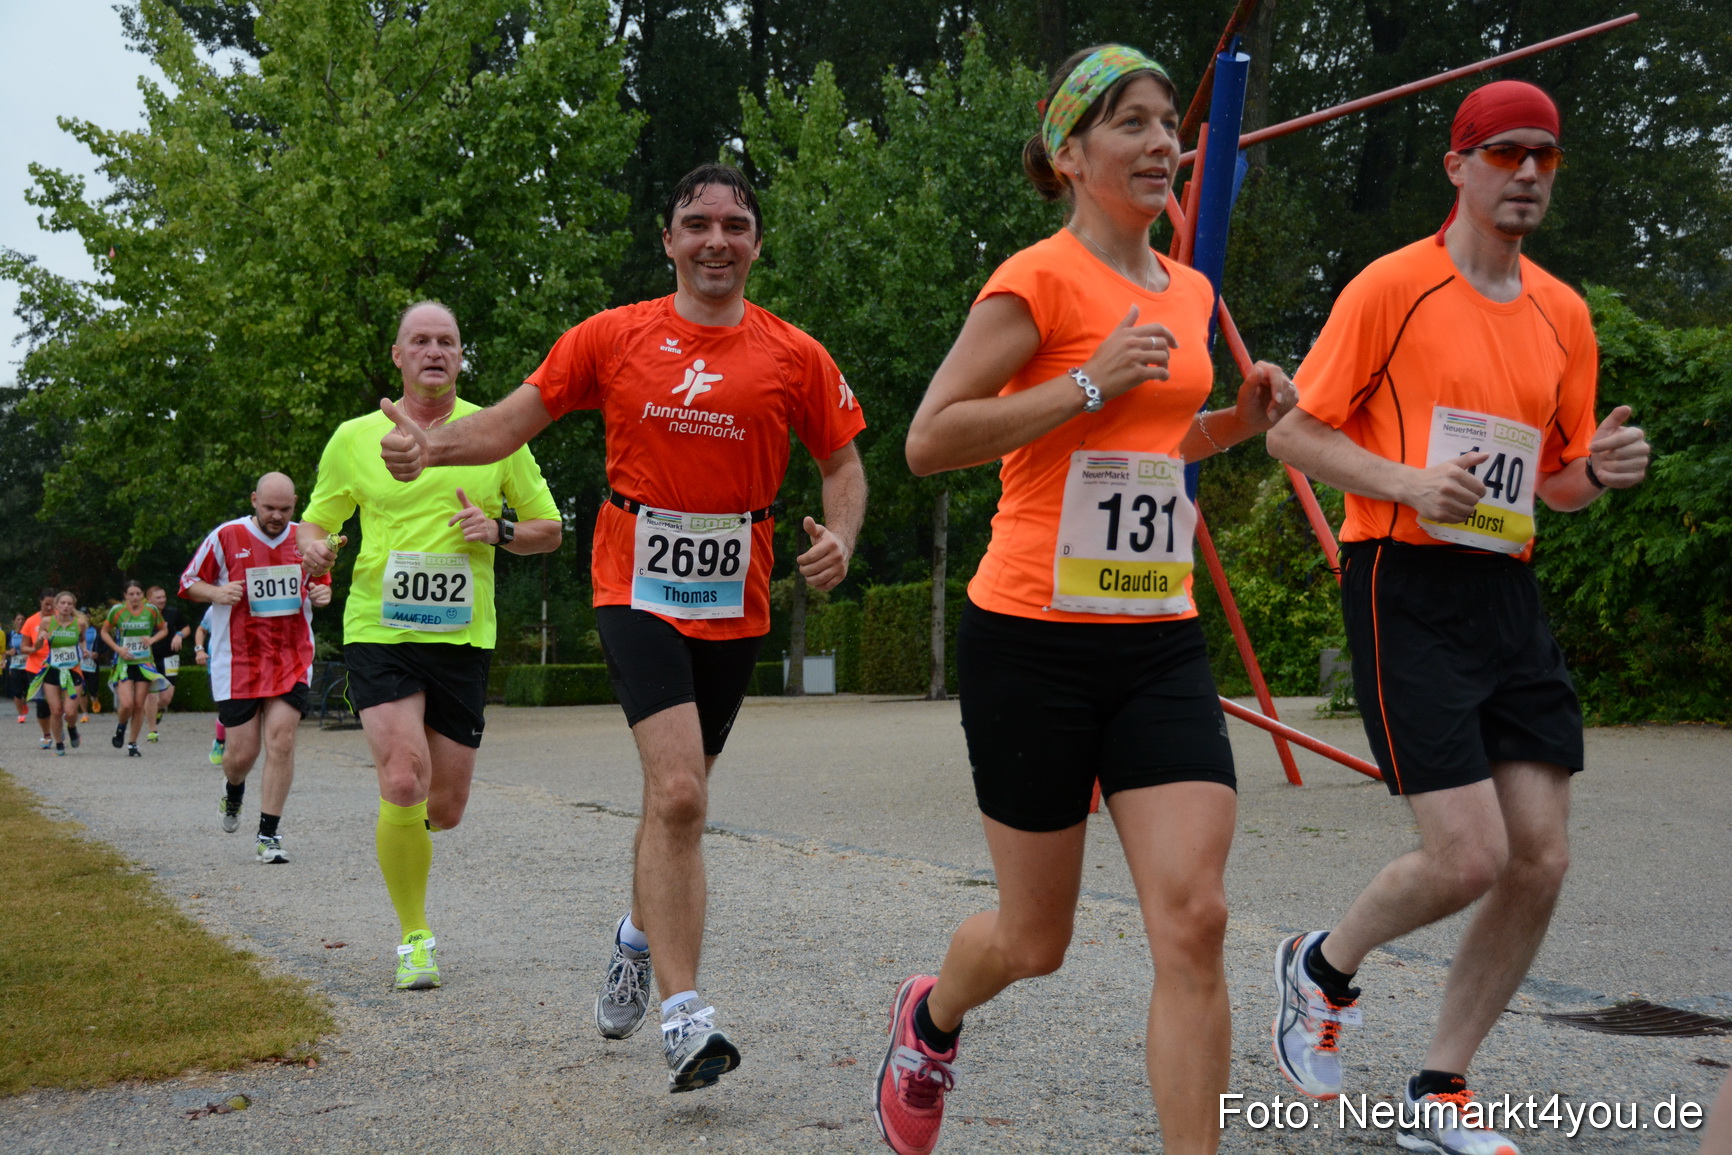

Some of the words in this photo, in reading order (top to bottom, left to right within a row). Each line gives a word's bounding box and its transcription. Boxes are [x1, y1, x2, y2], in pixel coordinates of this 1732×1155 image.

[642, 402, 734, 425] funrunners
[668, 421, 746, 441] neumarkt
[1443, 424, 1487, 438] NeuerMarkt
[1494, 422, 1535, 449] BOCK
[1082, 470, 1129, 480] NeuerMarkt
[647, 518, 683, 530] NeuerMarkt
[690, 517, 741, 530] BOCK
[1098, 493, 1177, 553] 131
[1464, 509, 1504, 533] Horst
[425, 555, 465, 566] BOCK
[647, 534, 741, 577] 2698
[254, 577, 298, 598] 3019
[392, 571, 467, 602] 3032
[1099, 567, 1168, 592] Claudia
[663, 585, 718, 604] Thomas
[54, 651, 76, 663] 2830
